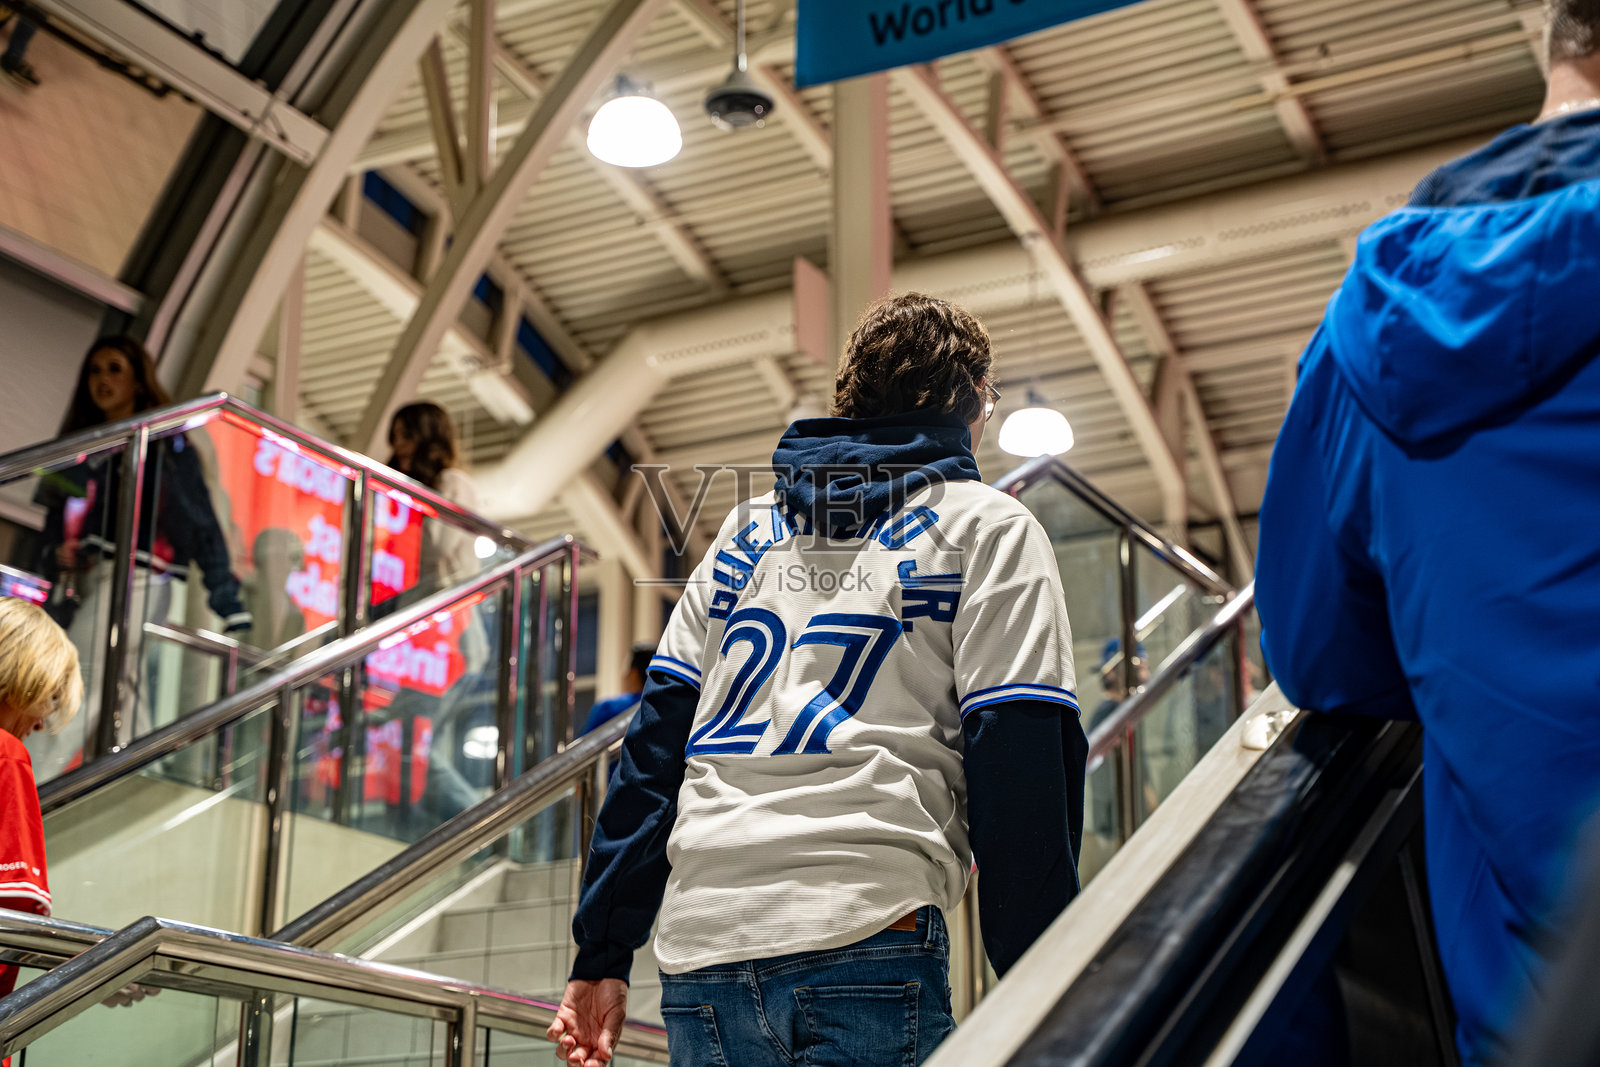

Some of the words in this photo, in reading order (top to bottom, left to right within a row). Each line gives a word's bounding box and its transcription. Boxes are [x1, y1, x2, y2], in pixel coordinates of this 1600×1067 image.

[708, 502, 940, 621] GUERO
[896, 558, 962, 633] JR.
[684, 607, 904, 762] 27
